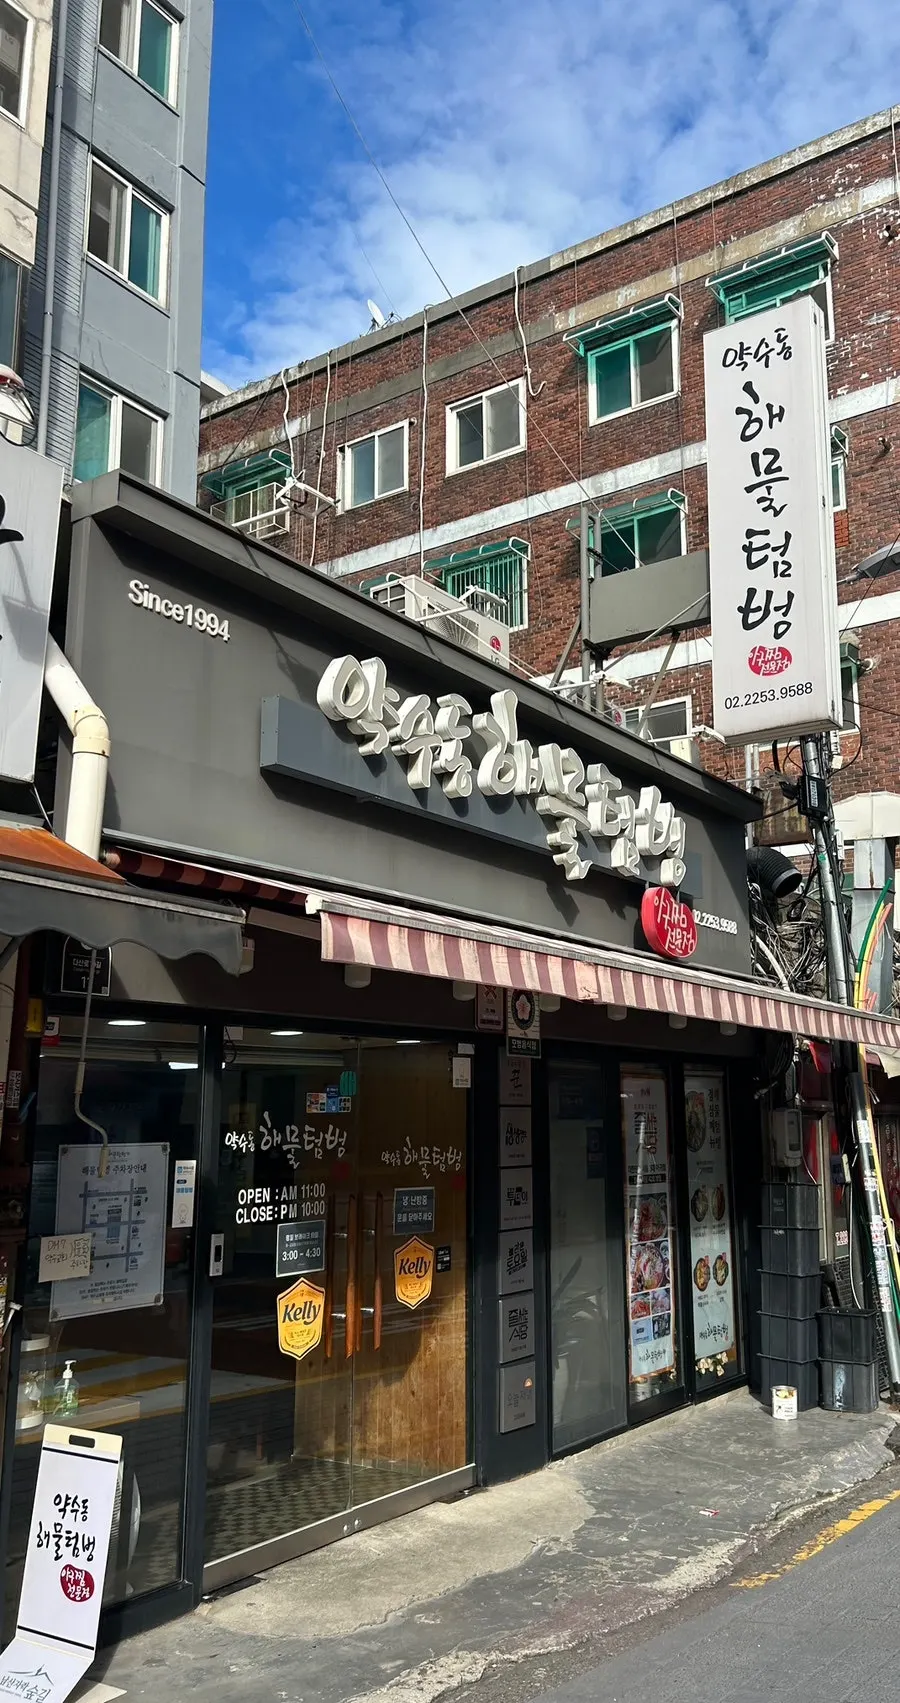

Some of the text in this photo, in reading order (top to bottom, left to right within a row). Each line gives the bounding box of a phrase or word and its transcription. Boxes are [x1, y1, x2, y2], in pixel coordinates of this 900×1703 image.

[722, 328, 793, 371] 약수동
[735, 381, 795, 640] 해물텀벙
[748, 645, 783, 667] 아구찜
[759, 655, 791, 676] 전문점
[724, 682, 813, 711] 02.2253.9588
[317, 654, 687, 886] 약수동 해물텀벙
[653, 887, 688, 931] 아구찜
[665, 927, 695, 953] 전문점
[511, 1038, 537, 1051] 모범음식점
[225, 1111, 347, 1169] 약수동 해물텀벙
[381, 1136, 462, 1179] 약수동 해물텀벙
[238, 1187, 271, 1205] OPEN
[280, 1185, 298, 1201] AM
[301, 1183, 326, 1198] 11:00
[301, 1201, 326, 1217] 10:00
[282, 1249, 299, 1262] 3:00
[305, 1247, 321, 1258] 4:30
[398, 1256, 431, 1279] Kelly
[282, 1300, 321, 1325] Kelly
[509, 1324, 528, 1342] 식당
[53, 1493, 88, 1523] 약수동
[37, 1521, 96, 1562] 해물텀벙
[61, 1567, 85, 1587] 아구찜
[67, 1583, 90, 1601] 전문점
